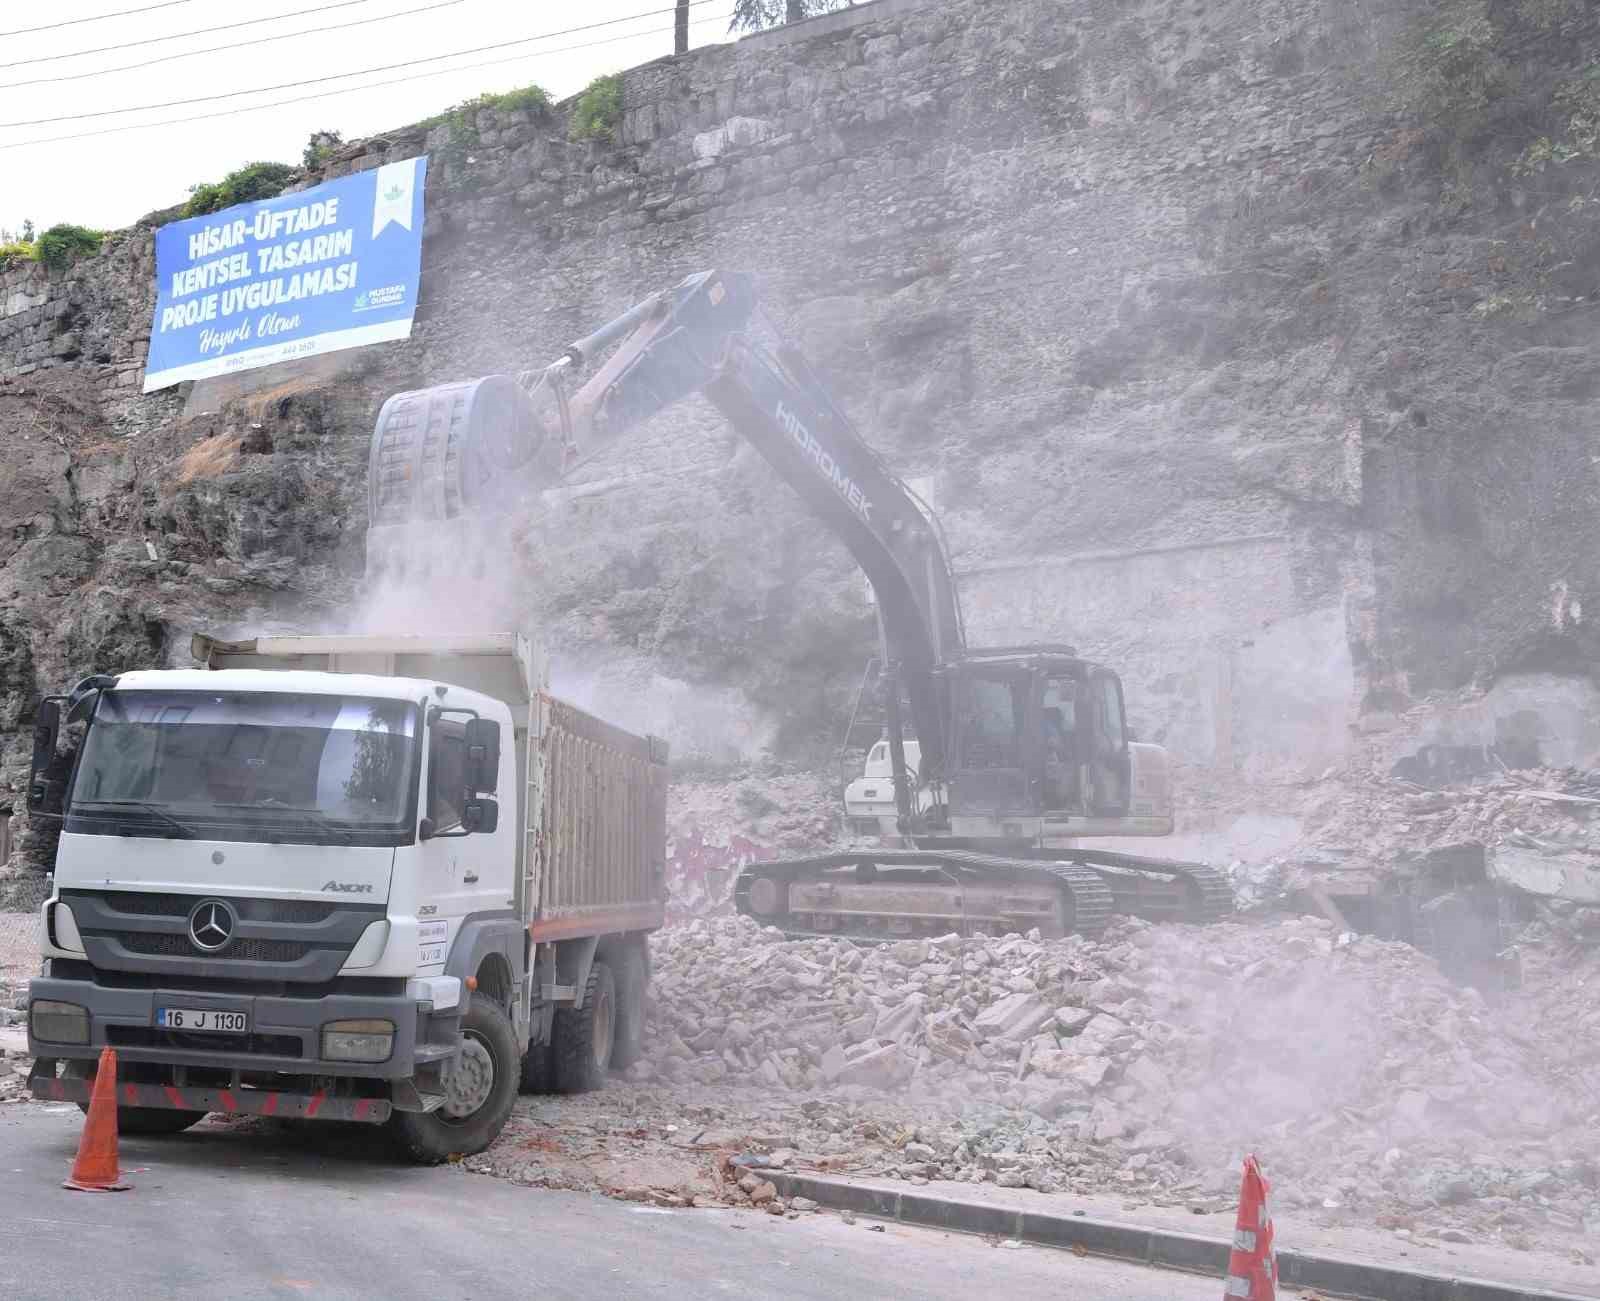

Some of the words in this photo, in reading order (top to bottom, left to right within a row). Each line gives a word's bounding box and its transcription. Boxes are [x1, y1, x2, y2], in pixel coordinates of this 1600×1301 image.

[188, 198, 339, 260] HİSAR-ÜFTADE
[172, 258, 251, 297] KENTSEL
[257, 229, 353, 273] TASARIM
[160, 295, 217, 332] PROJE
[221, 262, 358, 315] UYGULAMASI
[200, 317, 251, 355] Hayırlı
[258, 312, 301, 337] Olsun
[775, 400, 873, 521] HIDROMEK
[167, 1010, 183, 1026] 16
[194, 1011, 206, 1028] J
[214, 1013, 244, 1030] 1130
